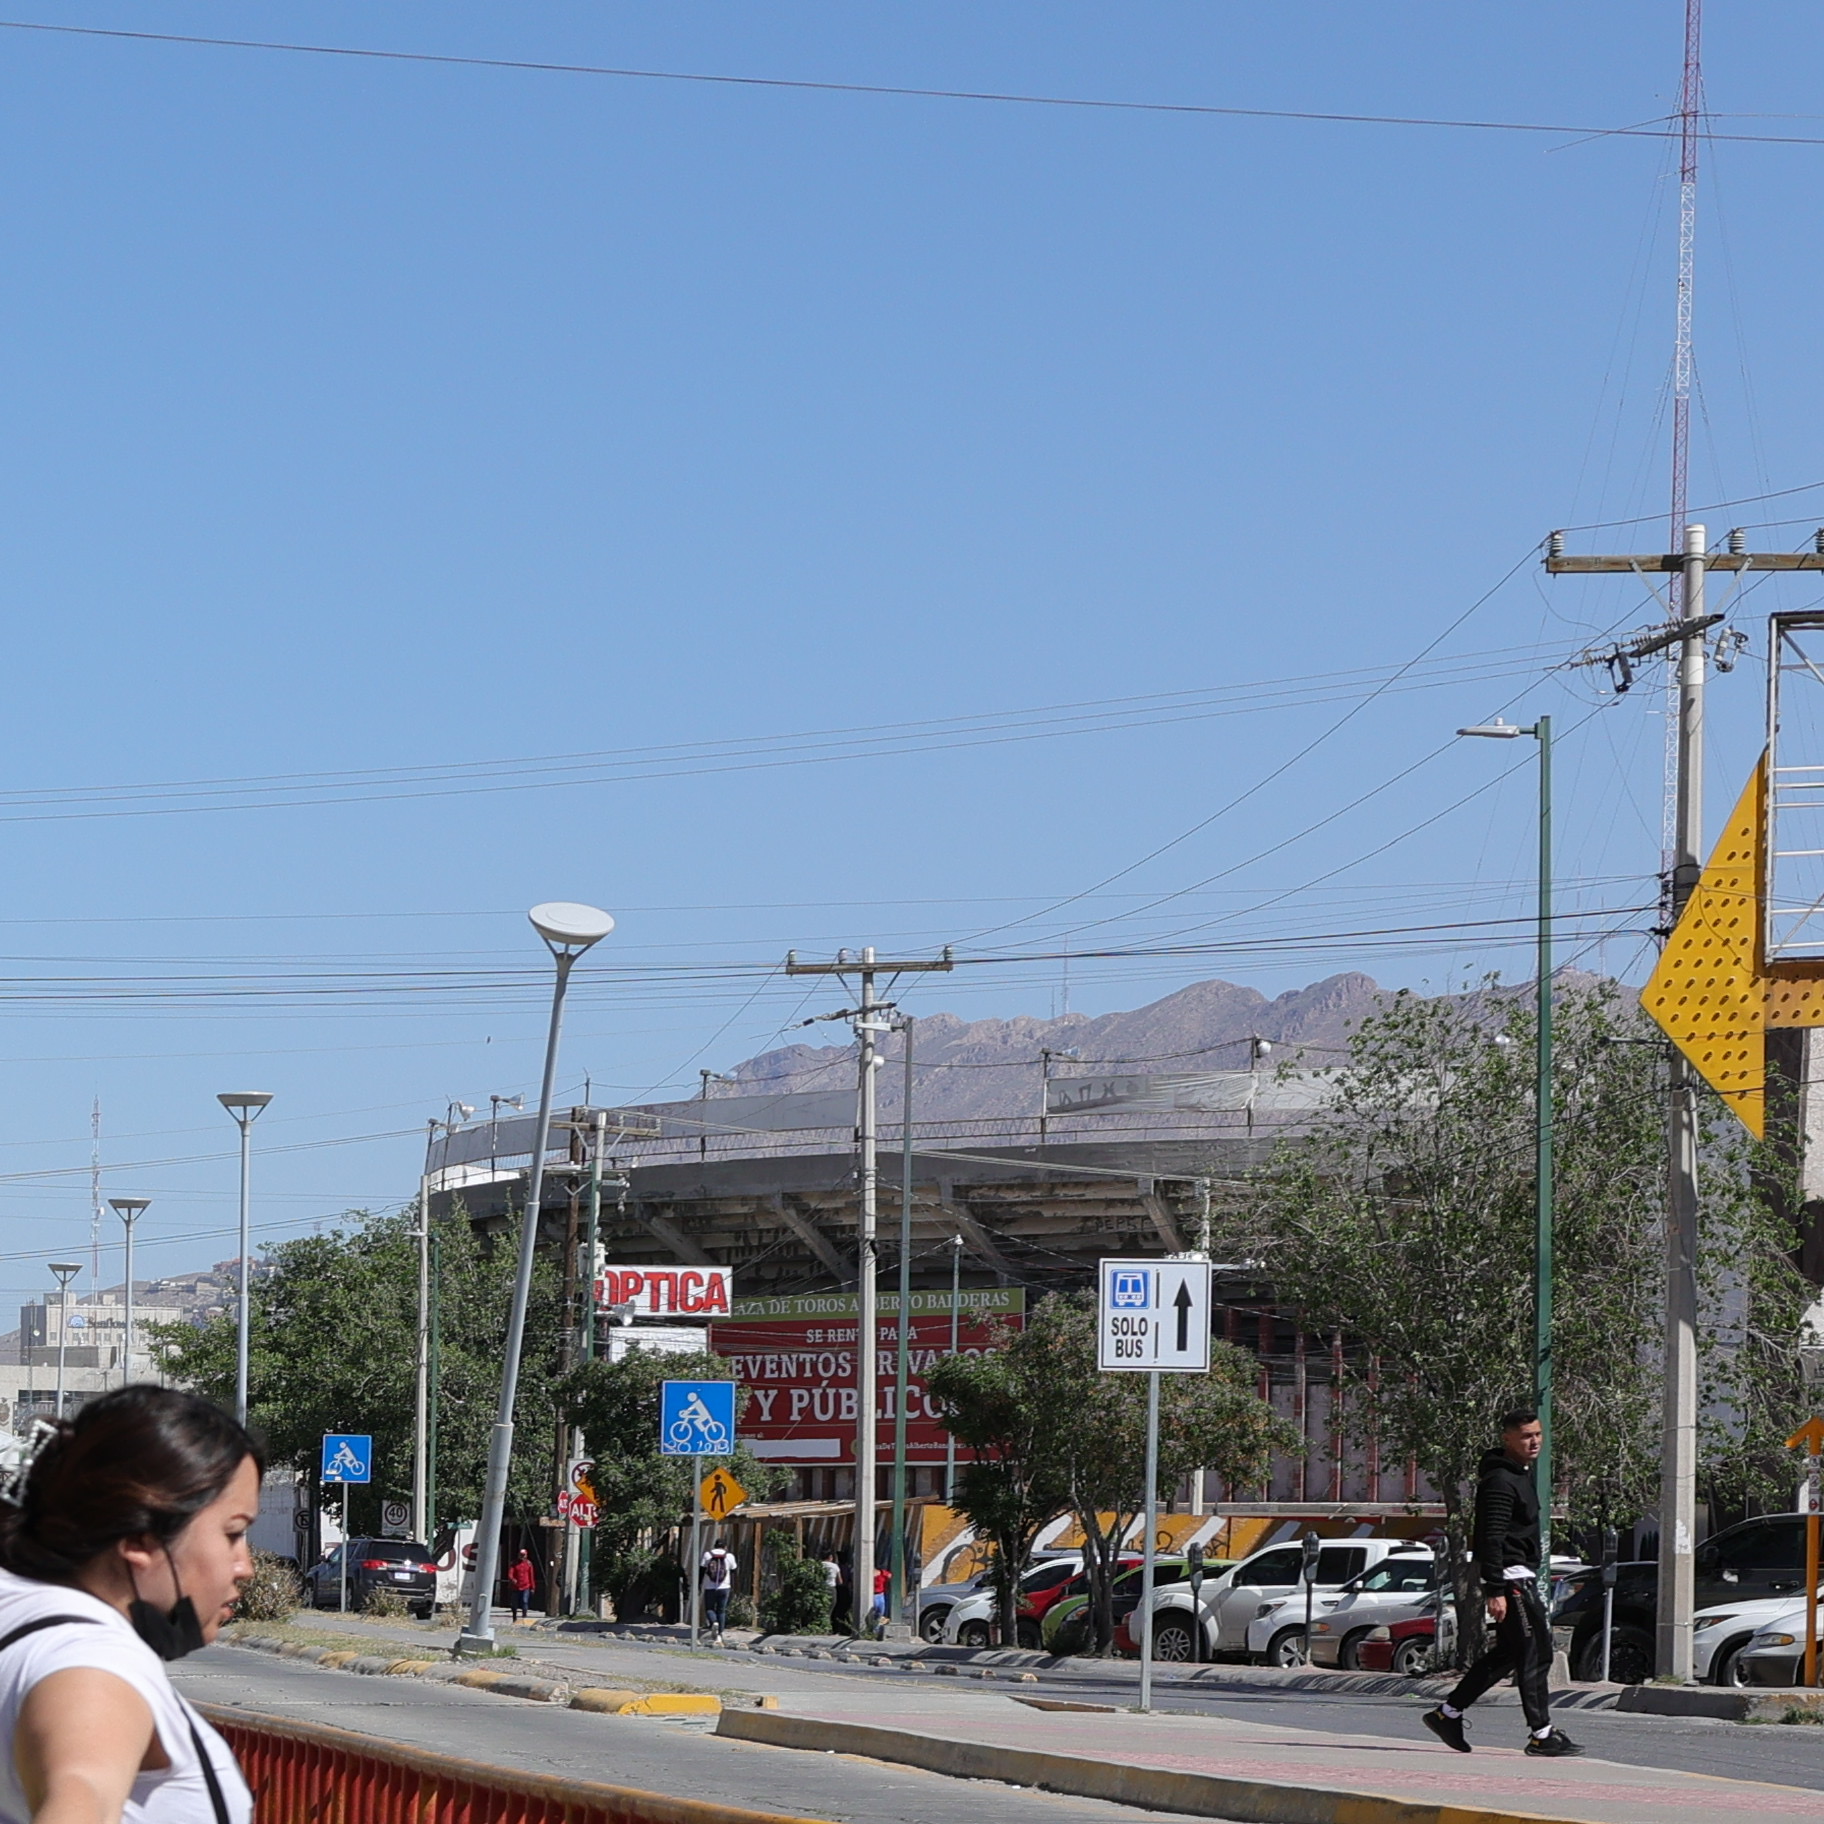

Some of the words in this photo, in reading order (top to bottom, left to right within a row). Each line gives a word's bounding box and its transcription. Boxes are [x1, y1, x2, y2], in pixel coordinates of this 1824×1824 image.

[602, 1271, 729, 1313] OPTICA
[769, 1301, 791, 1314] DE
[795, 1298, 845, 1313] TOROS
[1111, 1317, 1148, 1336] SOLO
[806, 1330, 823, 1343] SE
[1115, 1339, 1143, 1358] BUS
[732, 1353, 851, 1379] EVENTOS
[755, 1389, 778, 1422] Y
[388, 1507, 403, 1519] 40
